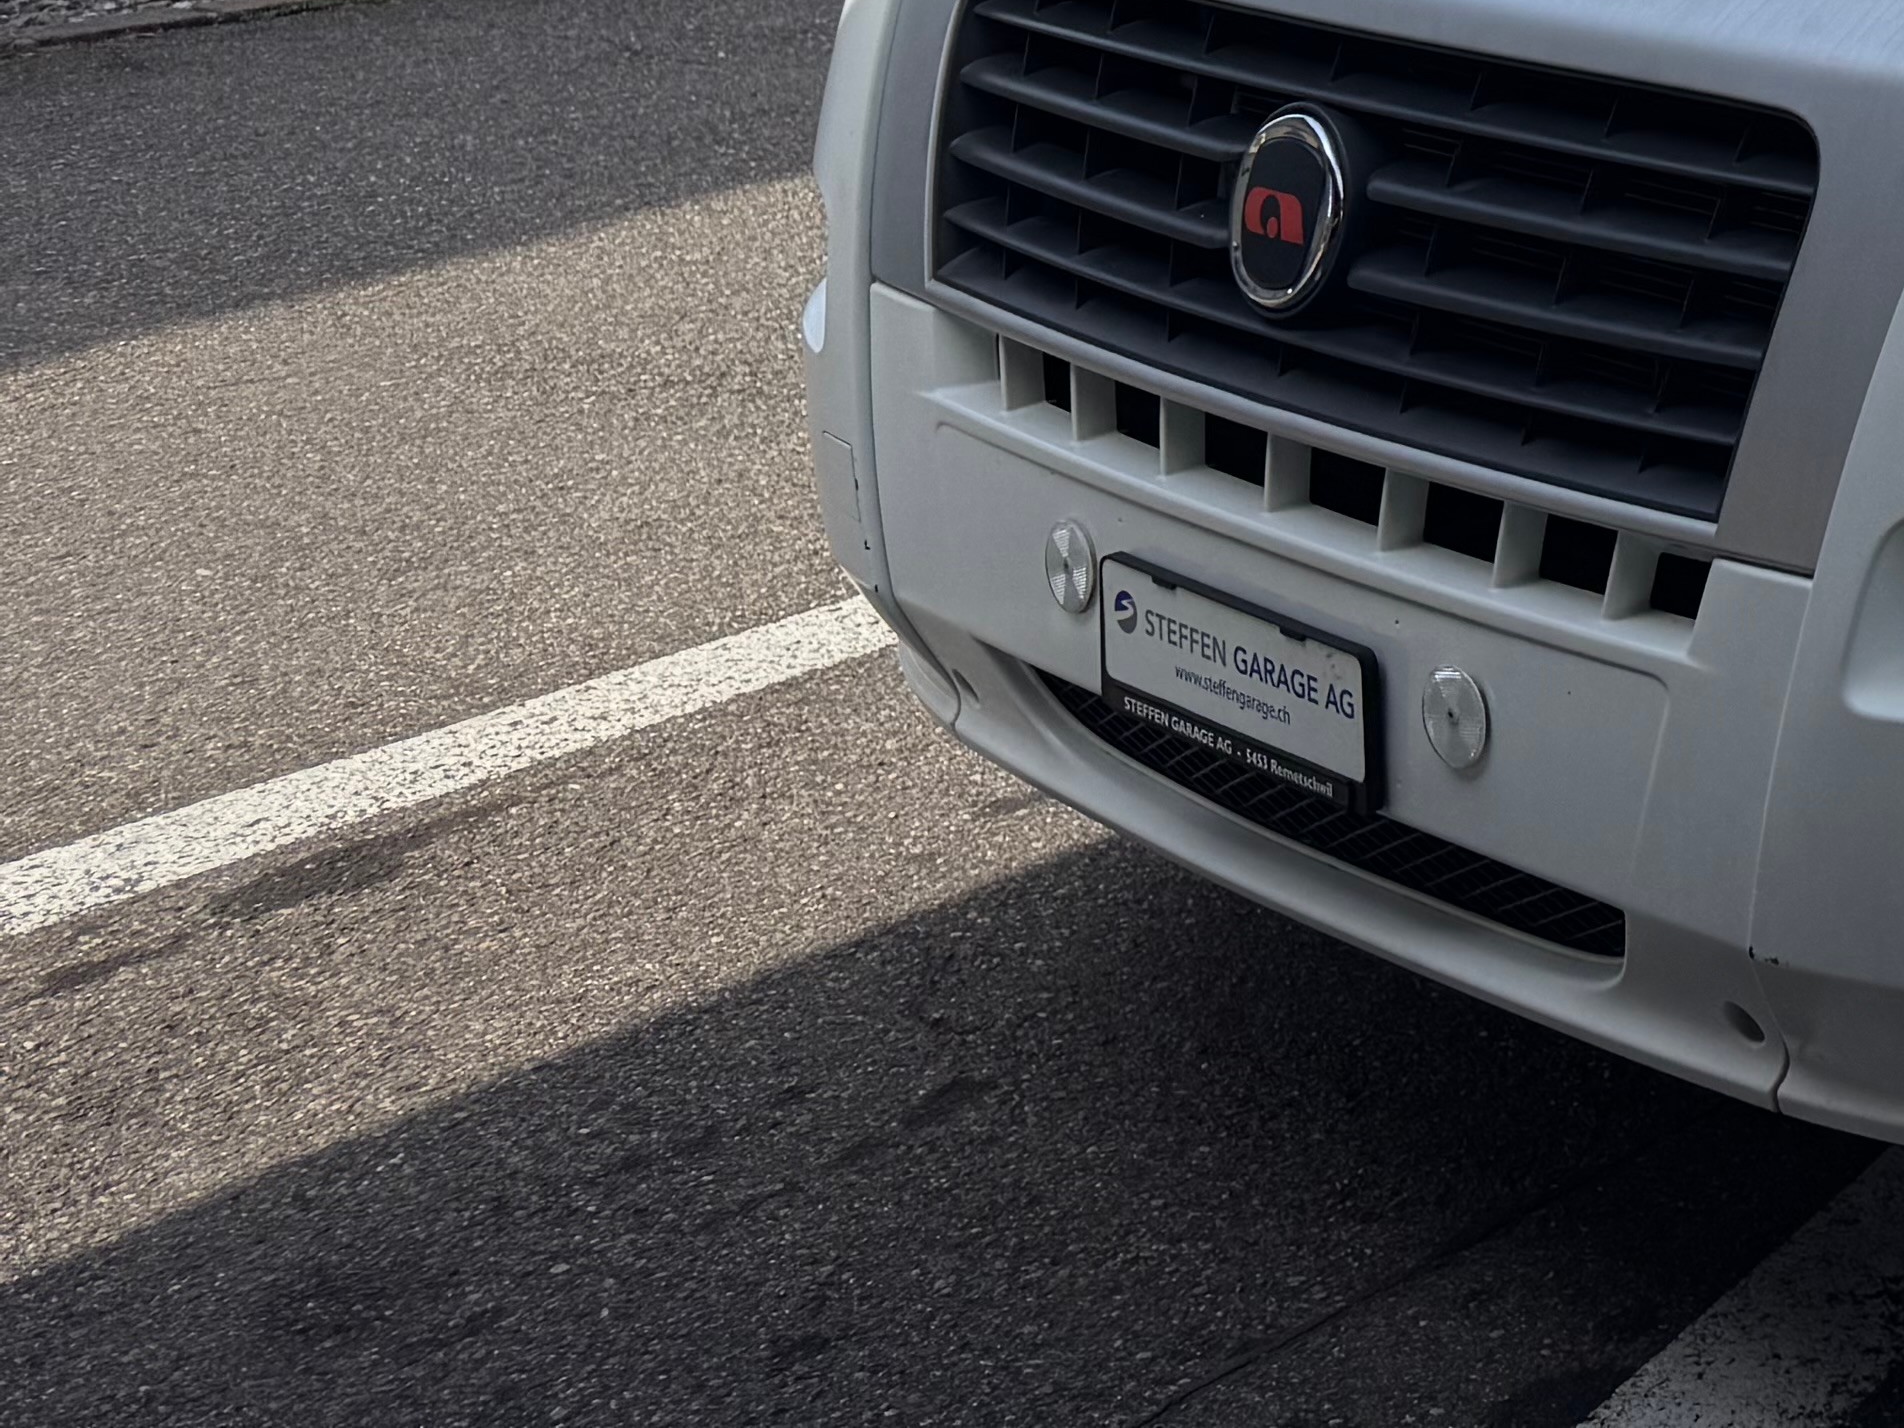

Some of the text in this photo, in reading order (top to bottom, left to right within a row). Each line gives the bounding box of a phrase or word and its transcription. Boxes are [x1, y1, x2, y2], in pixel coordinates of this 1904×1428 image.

[1144, 609, 1355, 720] STEFFEN GARAGE AG
[1175, 665, 1291, 726] www.steffengarage.ch
[1124, 696, 1334, 798] STEFFEN GARAGE AG 5453 Remetschwil
